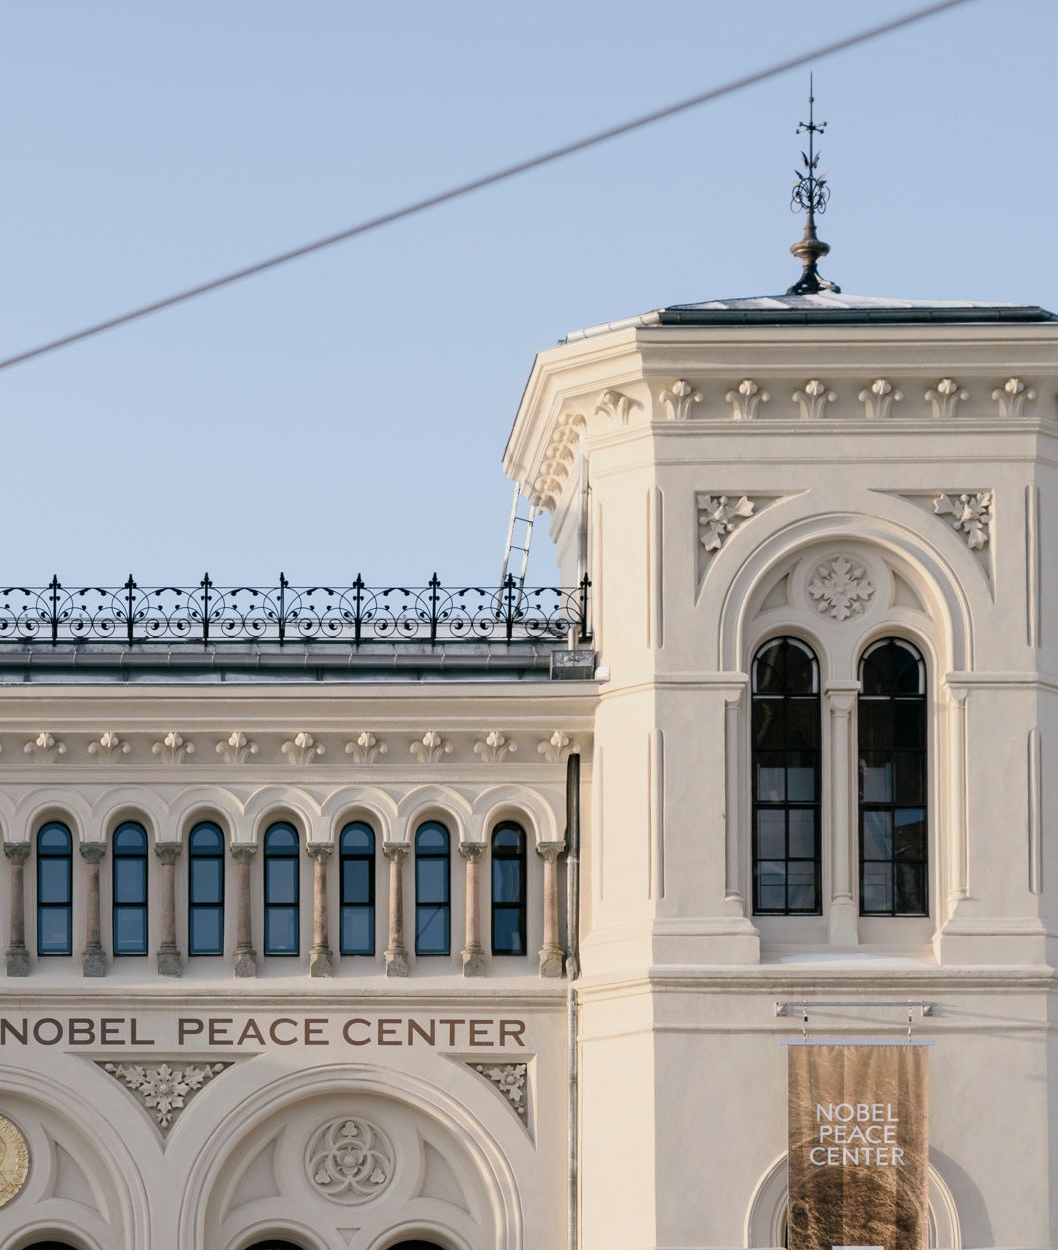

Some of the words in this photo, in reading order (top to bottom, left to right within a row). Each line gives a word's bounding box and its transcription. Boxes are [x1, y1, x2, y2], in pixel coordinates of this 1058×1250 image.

[0, 1017, 156, 1046] NOBEL
[177, 1017, 330, 1046] PEACE
[342, 1017, 527, 1047] CENTER
[816, 1103, 899, 1122] NOBEL
[819, 1125, 896, 1144] PEACE
[809, 1146, 906, 1166] CENTER
